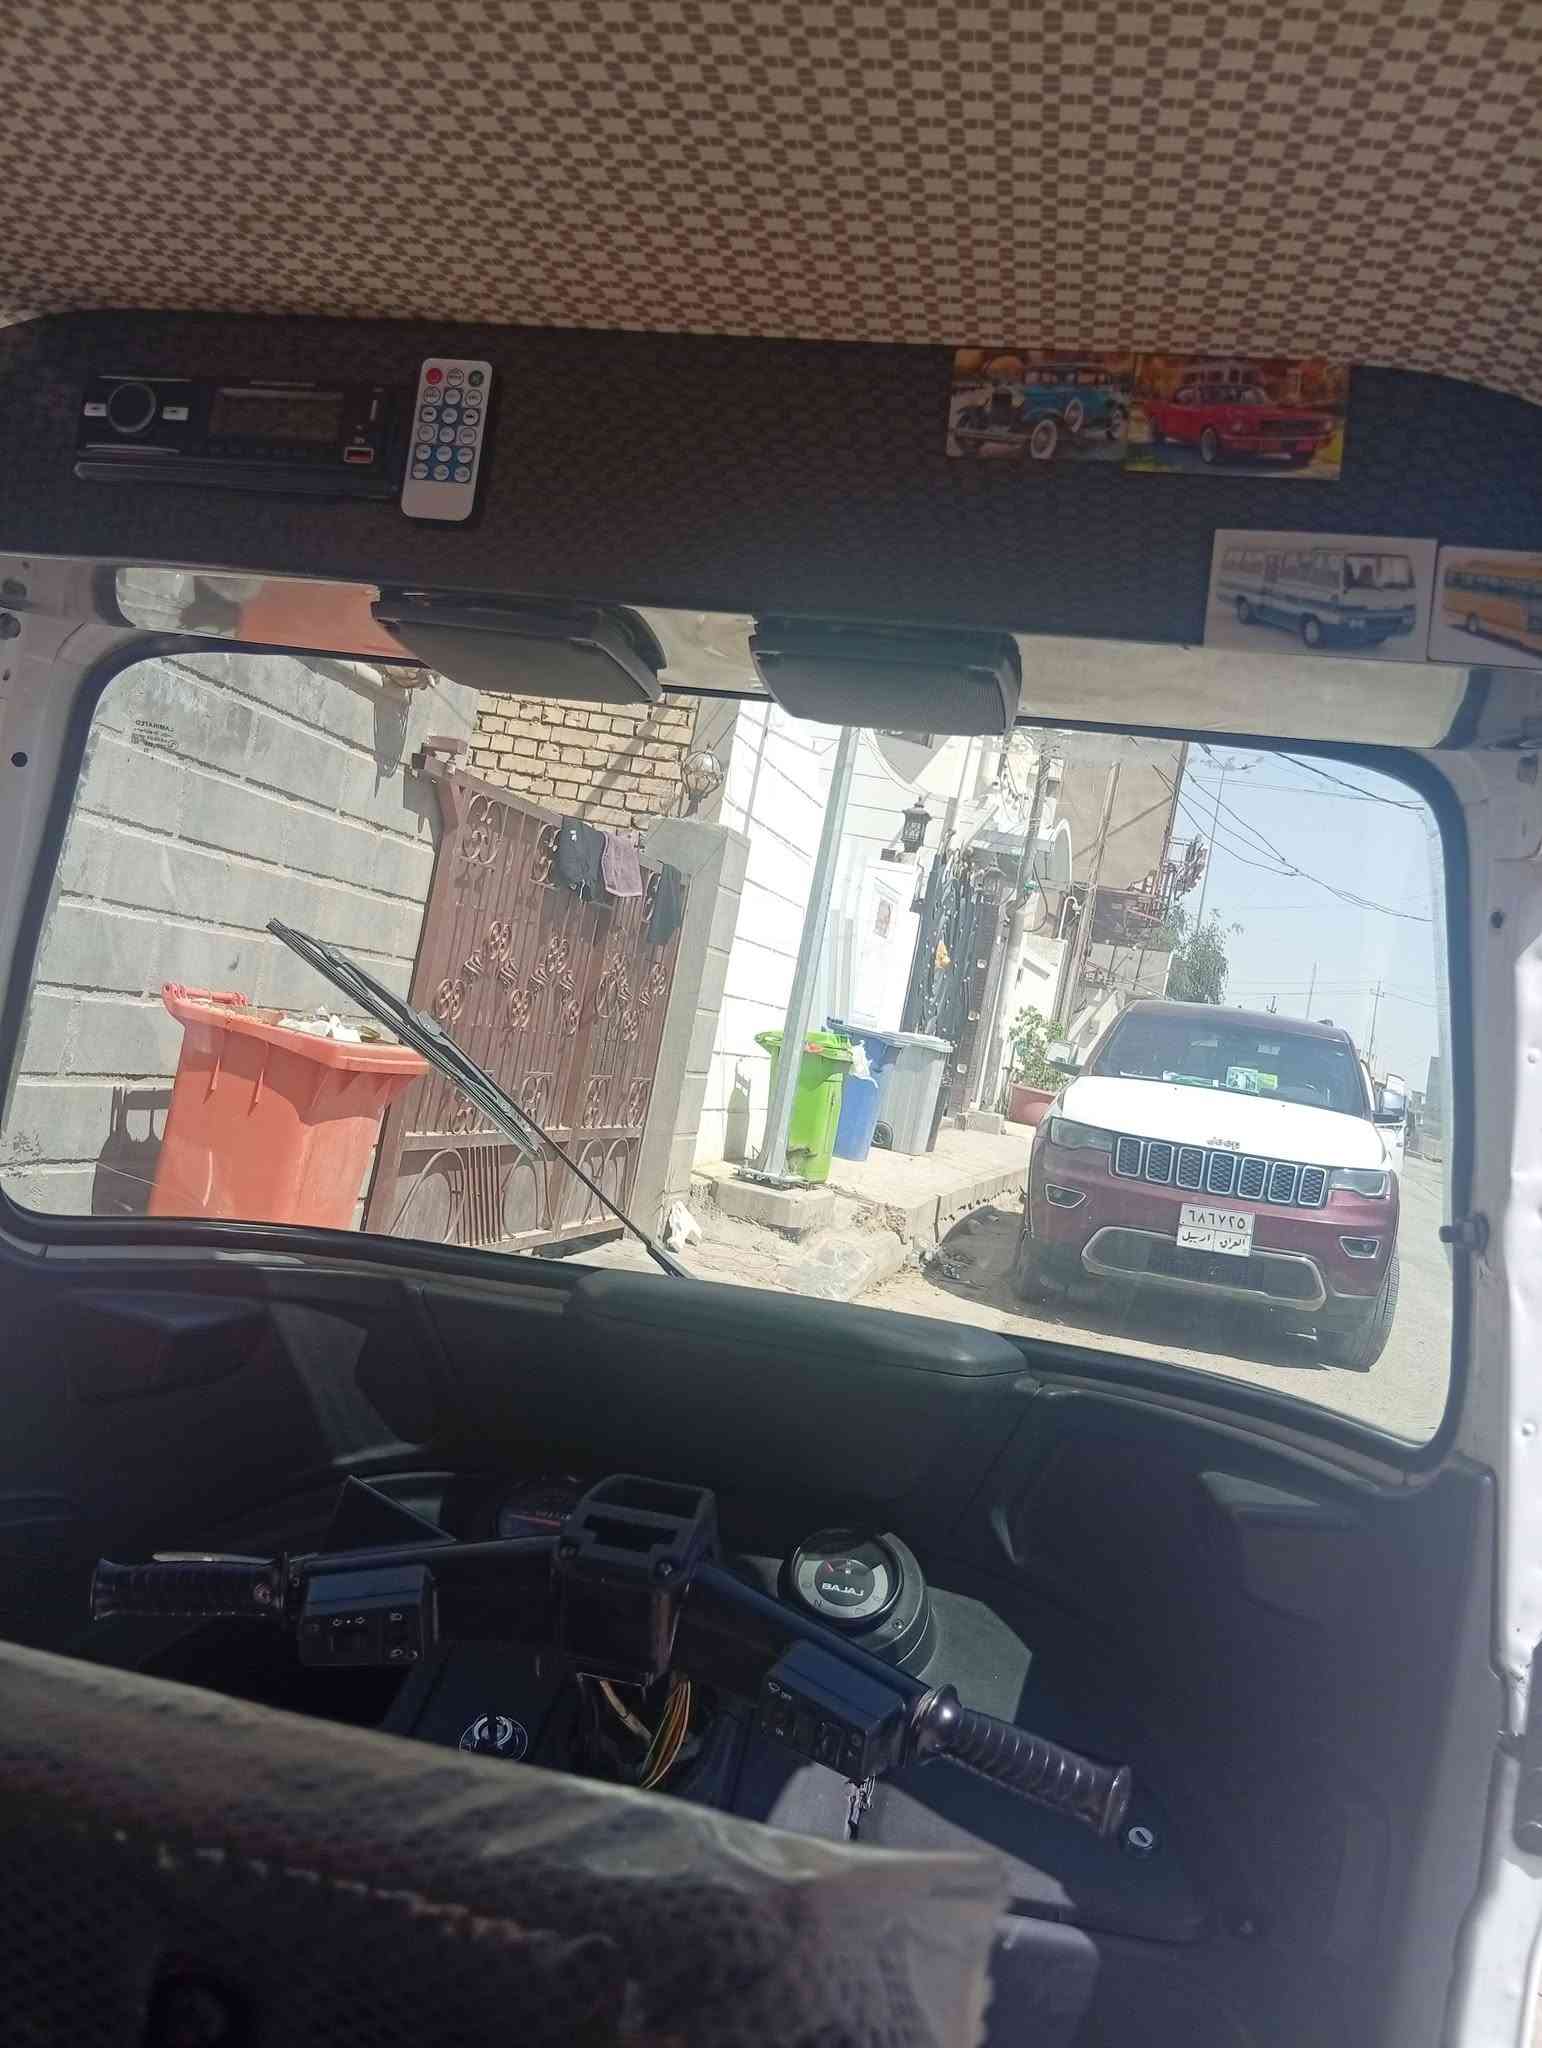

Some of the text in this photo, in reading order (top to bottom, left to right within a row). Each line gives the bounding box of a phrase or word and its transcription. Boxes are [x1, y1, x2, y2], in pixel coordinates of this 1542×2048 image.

[1206, 1136, 1240, 1150] Jeep
[1188, 1209, 1246, 1229] ٦٨٦٧٢٥
[821, 1582, 864, 1596] BAJAJ
